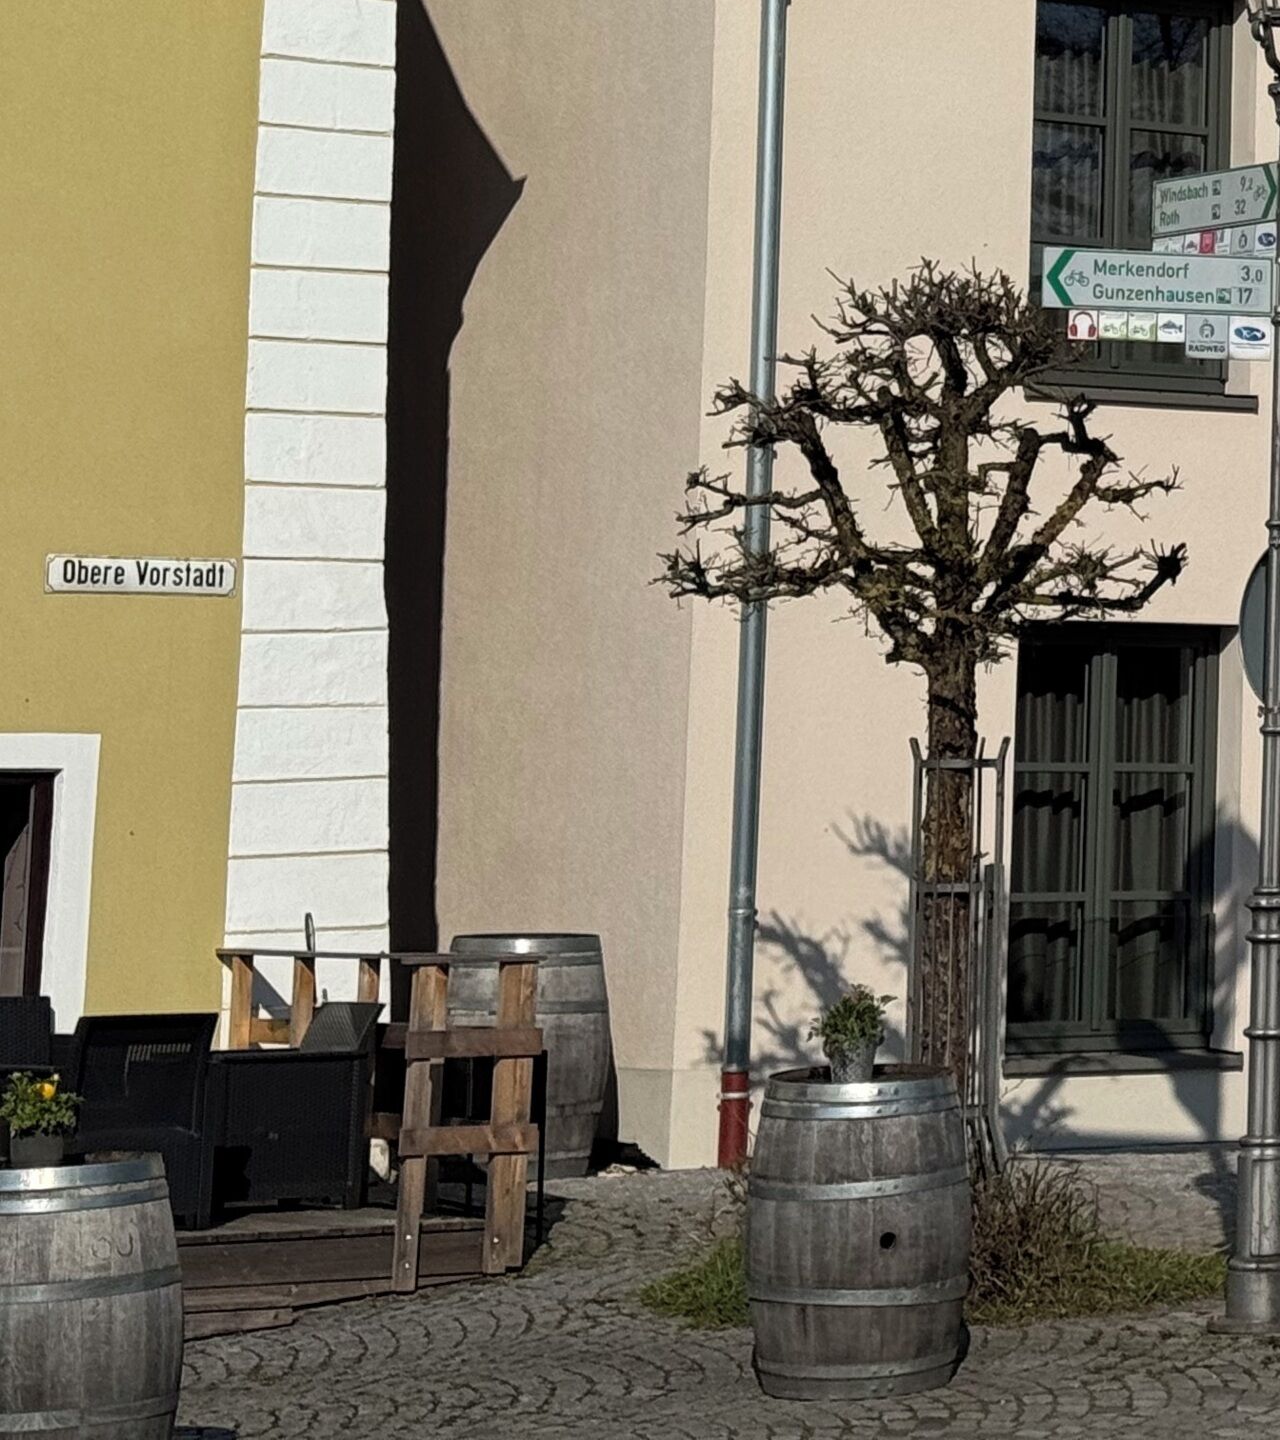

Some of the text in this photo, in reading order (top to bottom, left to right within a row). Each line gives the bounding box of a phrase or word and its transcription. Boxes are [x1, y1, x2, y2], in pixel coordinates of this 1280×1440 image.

[1160, 181, 1208, 202] Windsbach
[1160, 199, 1246, 226] Roth 32
[1093, 259, 1263, 284] Merkendorf 3,0
[1093, 283, 1253, 305] Gunzenhausen 17
[62, 559, 225, 588] Obere Vorstadt
